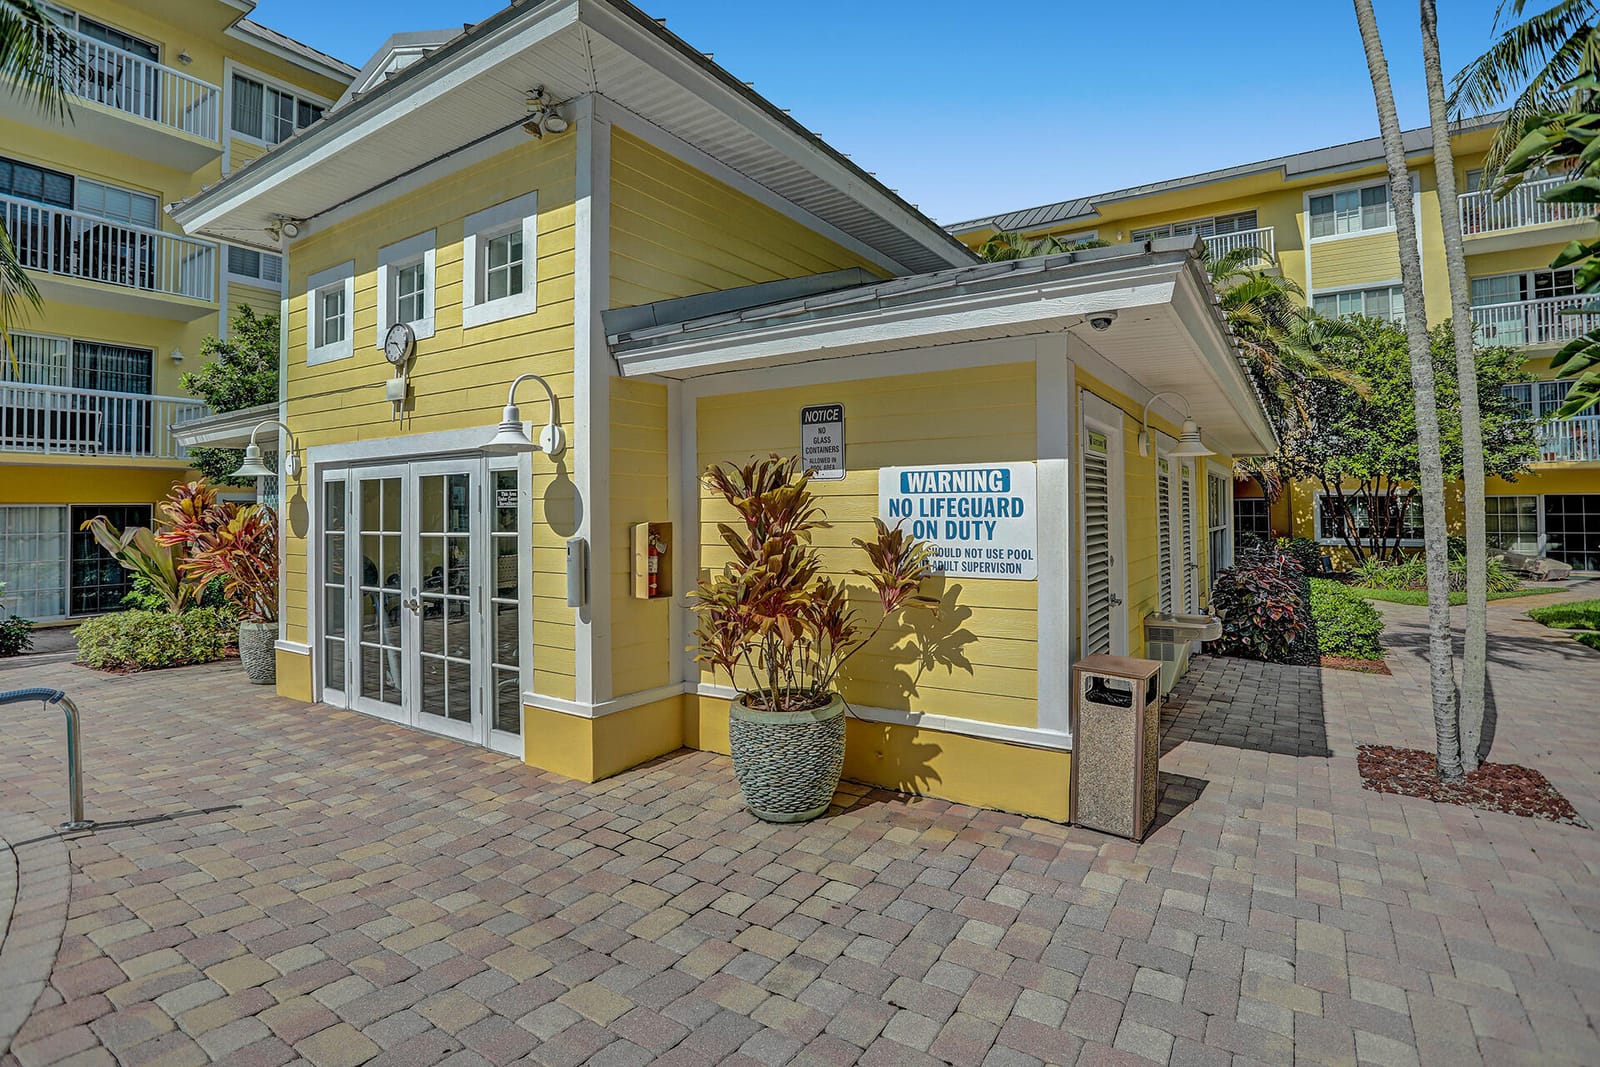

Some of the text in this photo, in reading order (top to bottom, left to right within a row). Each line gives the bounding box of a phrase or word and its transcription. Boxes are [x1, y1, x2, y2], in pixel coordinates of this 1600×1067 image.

[804, 409, 839, 422] NOTICE
[813, 436, 832, 444] GLASS
[806, 446, 840, 454] CONTAINERS
[907, 470, 1003, 493] WARNING
[889, 497, 1024, 518] NO LIFEGUARD
[912, 520, 997, 540] ON DUTY
[965, 548, 983, 559] NOT
[986, 549, 1004, 560] USE
[1008, 549, 1034, 560] POOL
[932, 560, 959, 572] ADULT
[962, 562, 1022, 574] SUPERVISION
